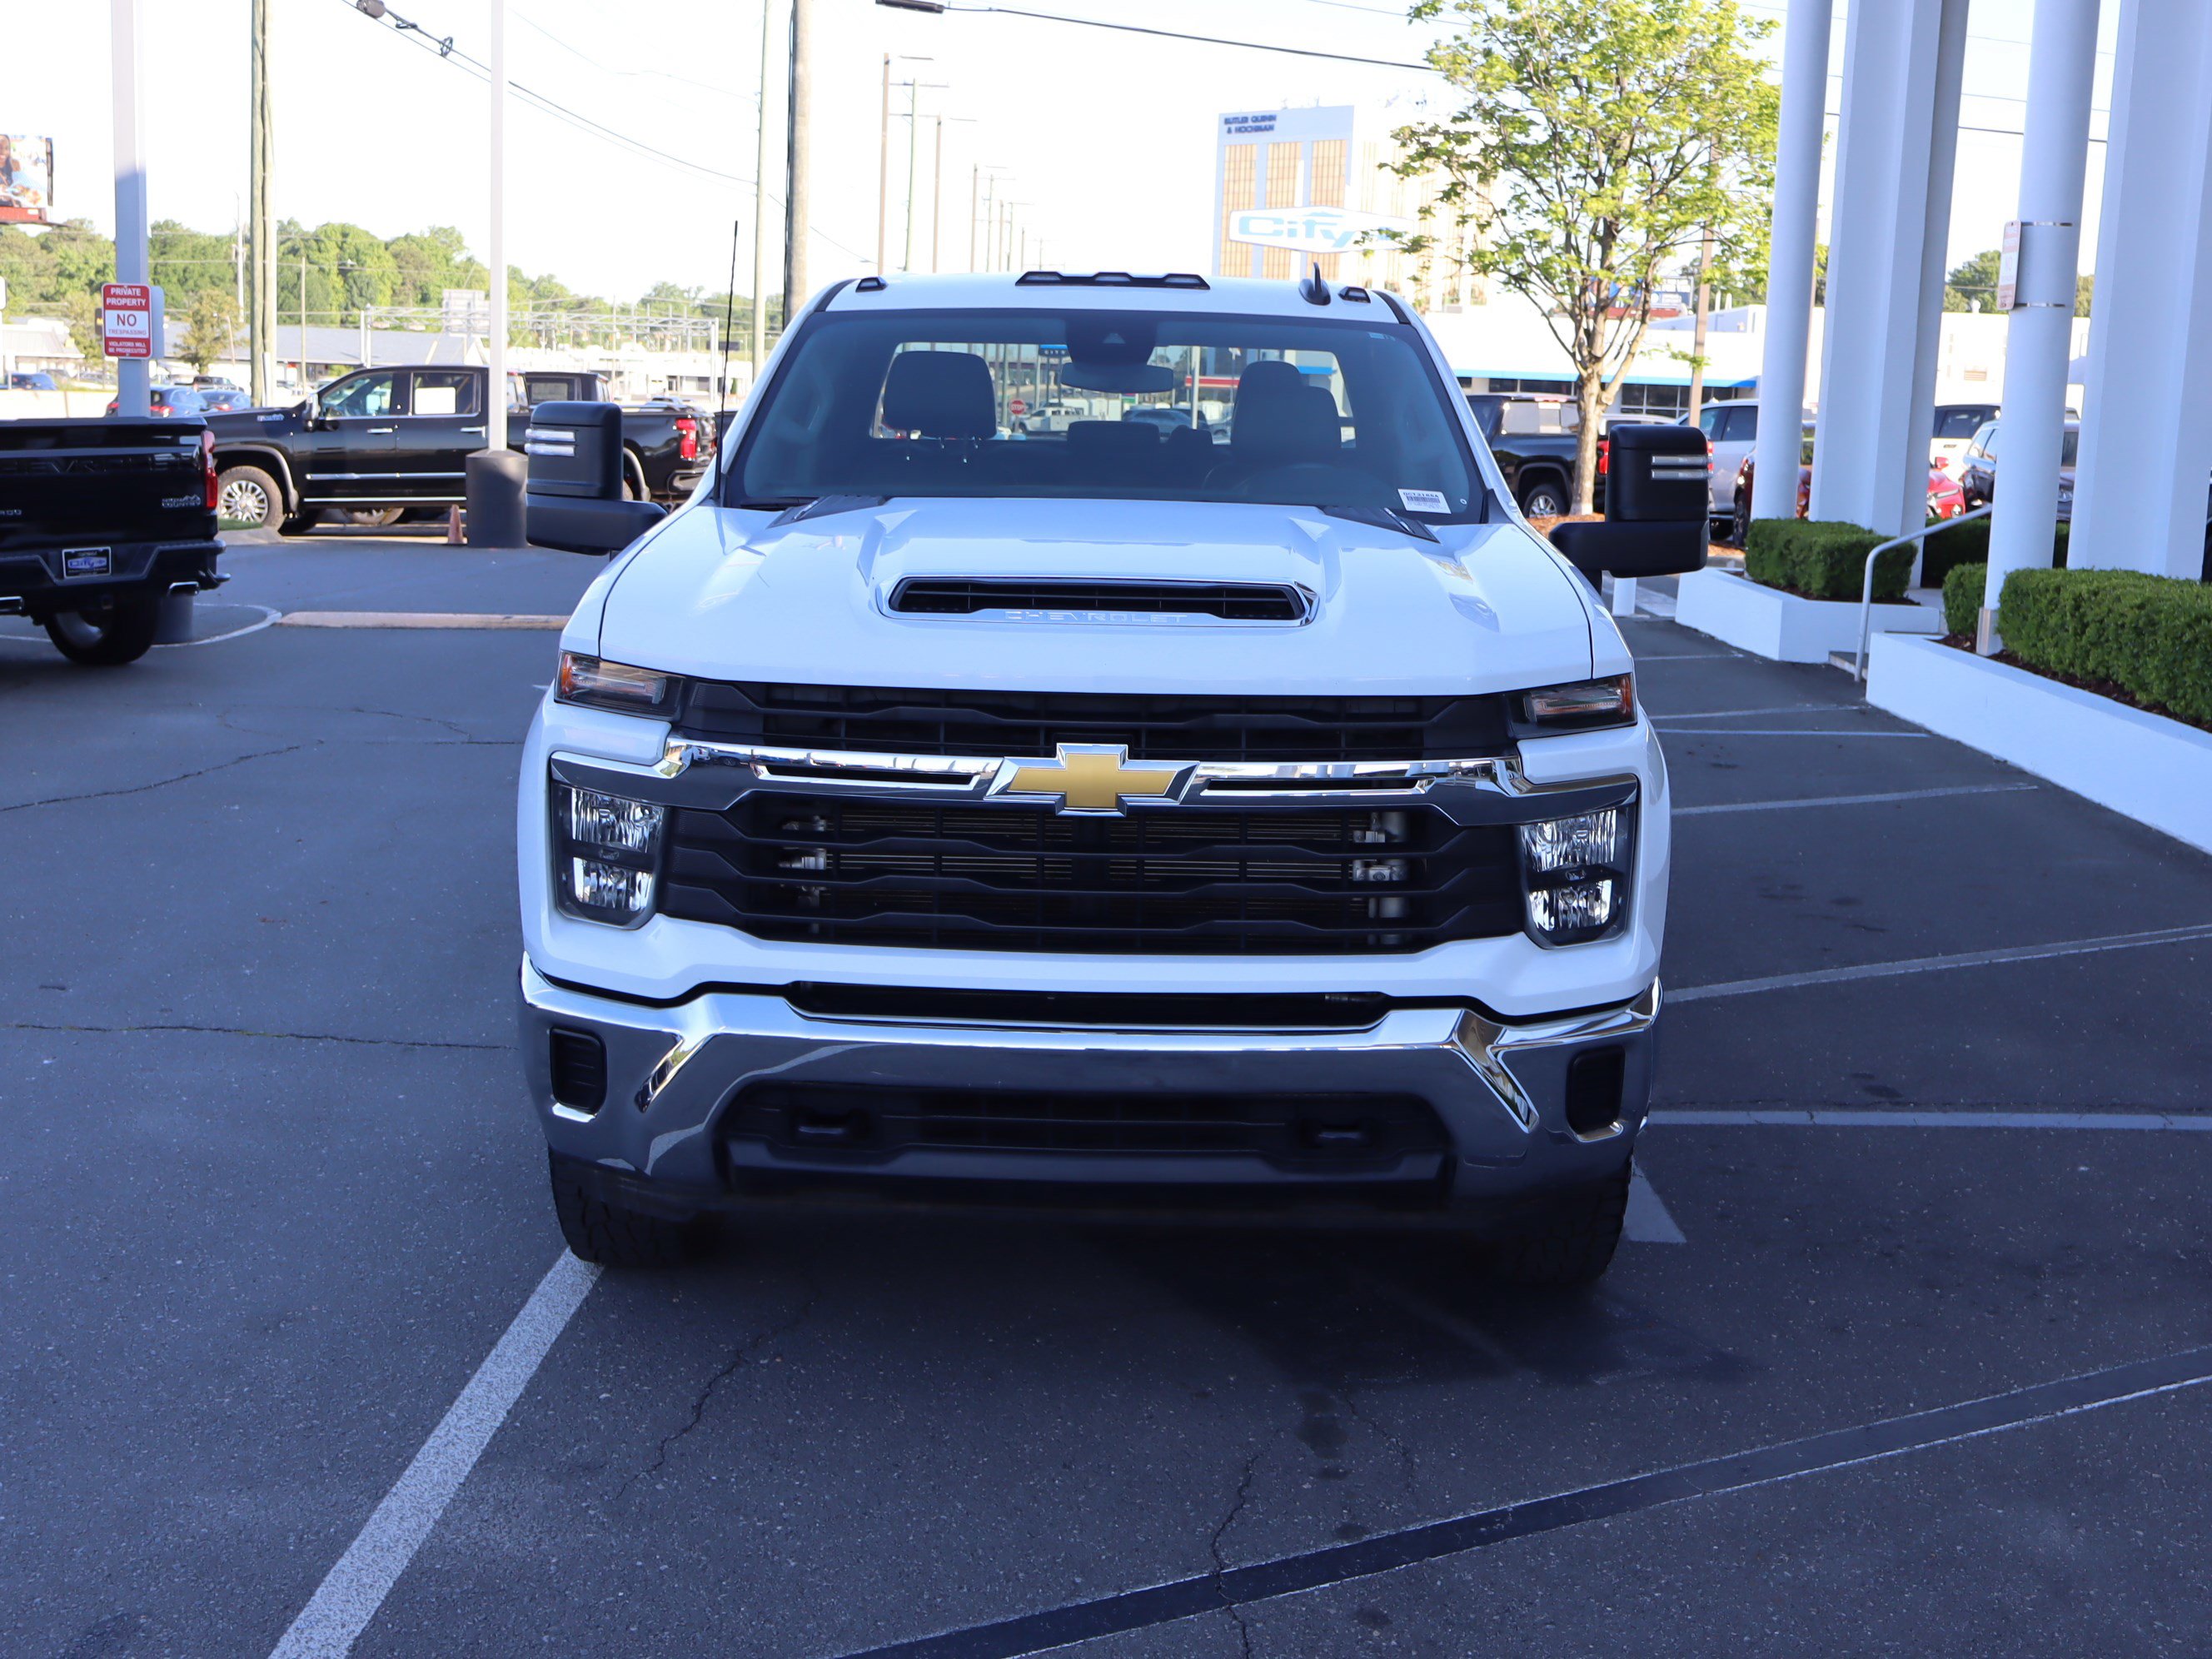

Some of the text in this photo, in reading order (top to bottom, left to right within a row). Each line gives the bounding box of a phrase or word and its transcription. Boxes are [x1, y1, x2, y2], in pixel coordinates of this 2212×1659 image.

[1238, 212, 1357, 247] City
[111, 287, 142, 296] PRIVATE
[107, 297, 147, 306] PROPERTY
[117, 313, 137, 326] NO
[1004, 610, 1188, 623] CHEVROLET
